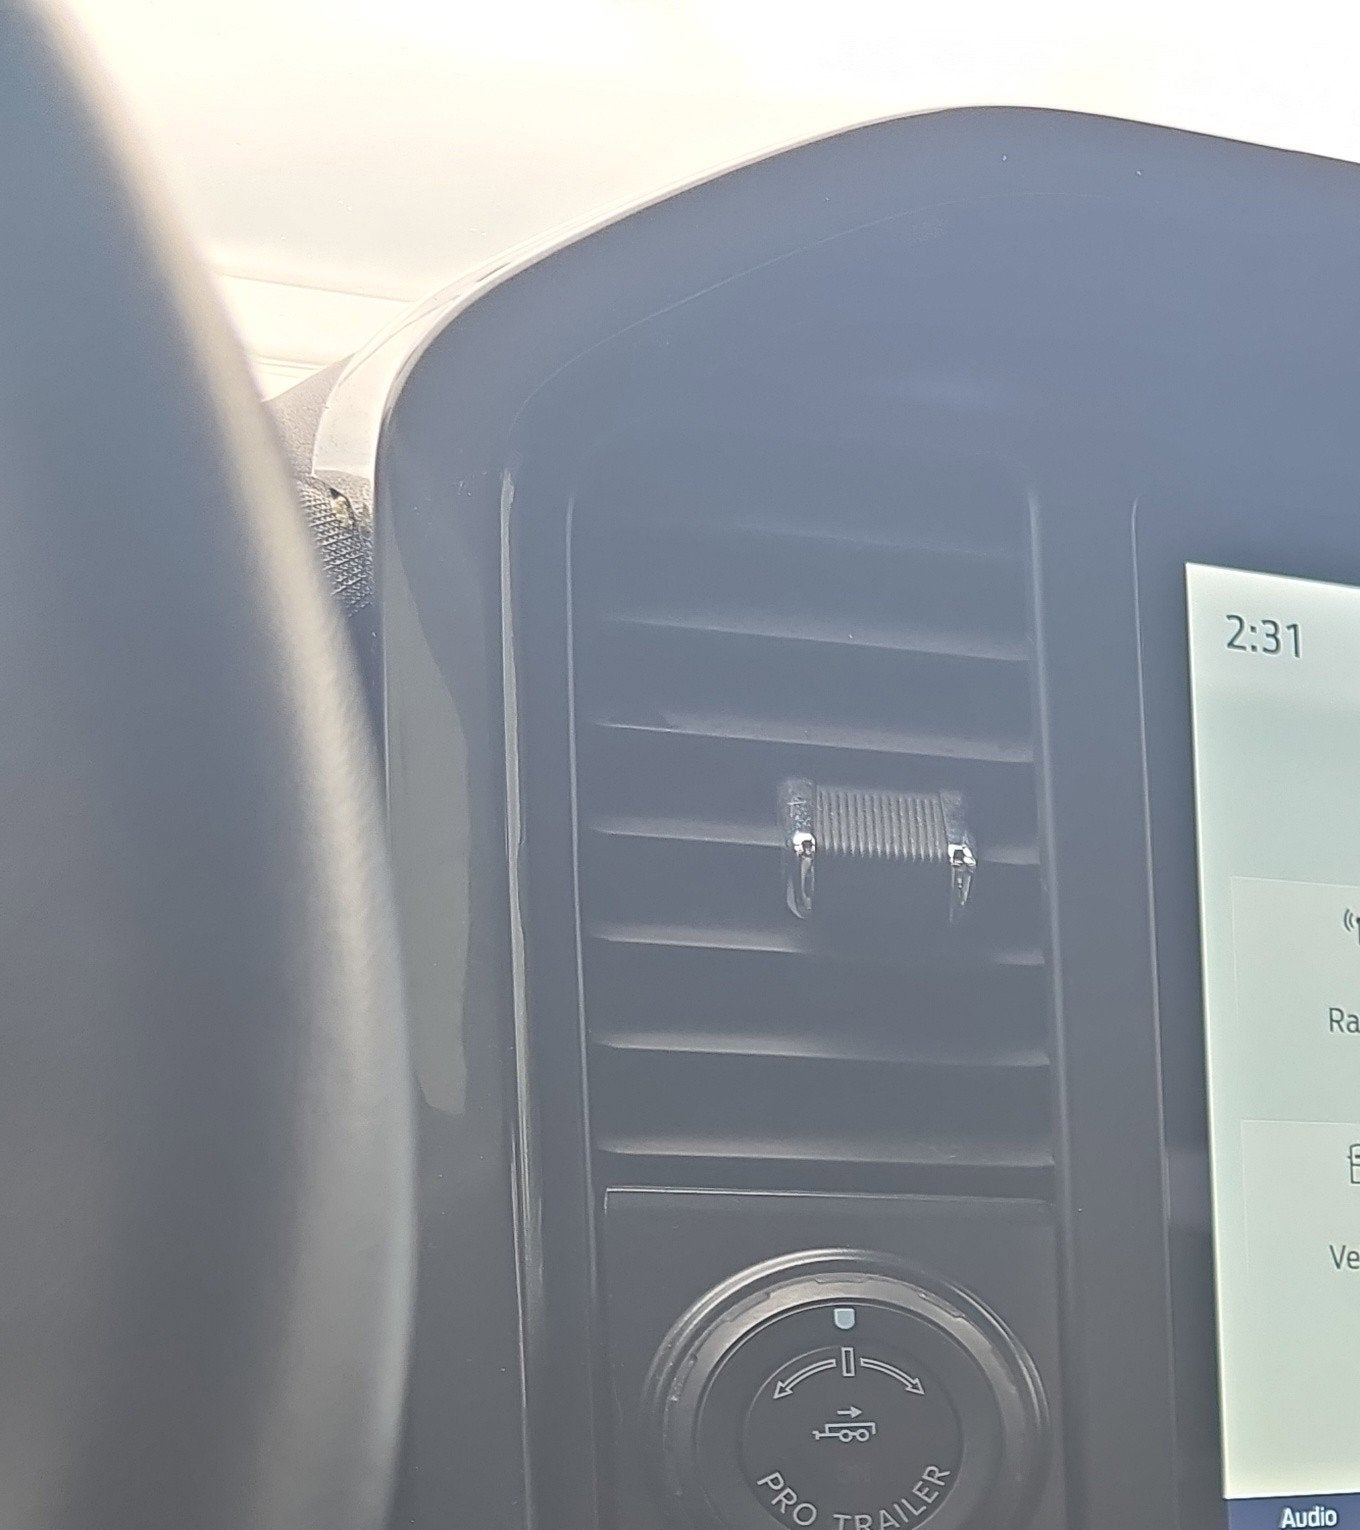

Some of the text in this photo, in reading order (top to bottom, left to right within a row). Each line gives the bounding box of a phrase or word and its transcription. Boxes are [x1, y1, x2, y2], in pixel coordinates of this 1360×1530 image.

[1224, 613, 1303, 658] 2:31
[756, 1470, 819, 1528] PRO
[1280, 1506, 1339, 1530] Audio
